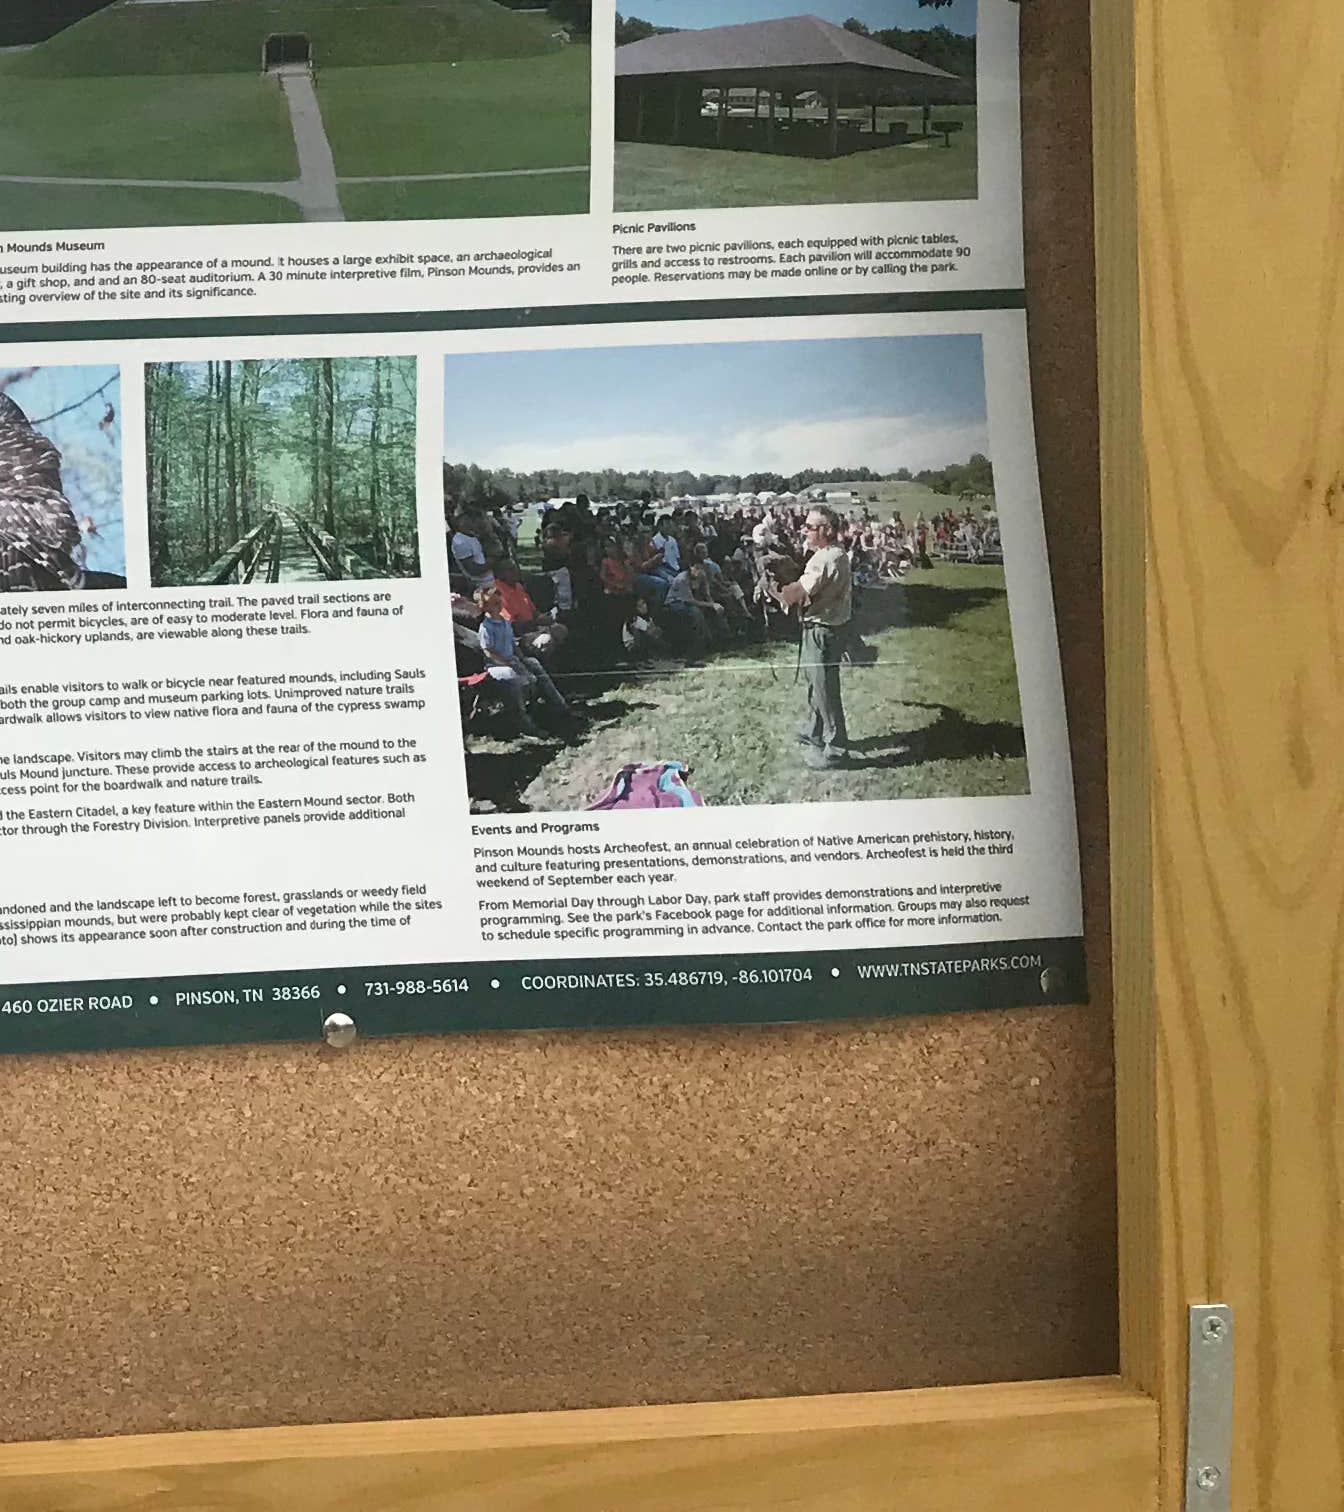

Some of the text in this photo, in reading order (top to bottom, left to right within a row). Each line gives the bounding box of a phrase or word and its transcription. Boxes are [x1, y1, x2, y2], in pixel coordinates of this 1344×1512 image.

[6, 241, 52, 252] Mounds
[55, 241, 105, 251] Museum
[471, 822, 600, 835] Events and Programs
[856, 954, 1041, 979] WWW.TNSTATEPARKS.COM
[364, 978, 469, 996] 731-988-5614
[521, 967, 812, 989] COORDINATES: 35.486719, -86.101704
[1, 995, 132, 1014] 460 OZIER ROAD
[175, 985, 320, 1005] PINSON, TN 38366
